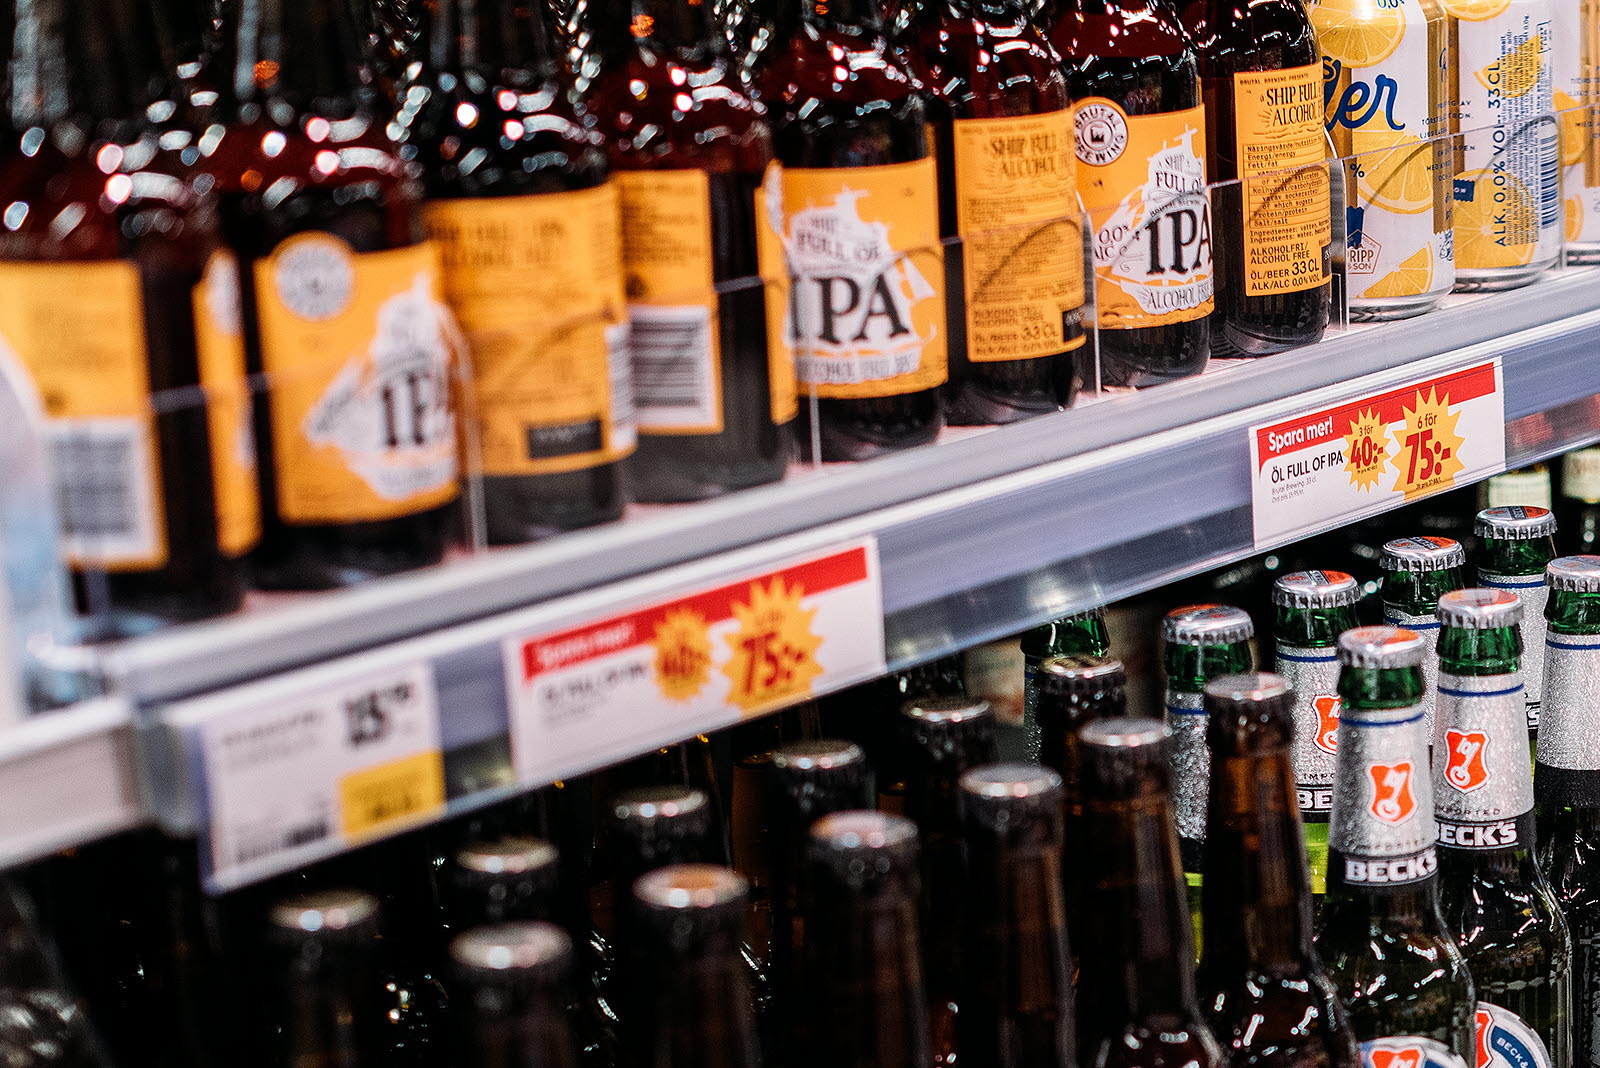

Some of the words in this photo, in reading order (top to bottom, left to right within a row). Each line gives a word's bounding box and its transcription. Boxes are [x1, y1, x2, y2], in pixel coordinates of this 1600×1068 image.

[1487, 57, 1501, 85] CL.
[1266, 86, 1296, 107] SHIP
[1299, 82, 1318, 102] FULL
[1487, 87, 1501, 109] 33
[1273, 102, 1318, 127] ALCOHOL
[1492, 160, 1507, 204] 0,0%
[1145, 203, 1214, 276] IPA
[1493, 208, 1507, 247] ALK.
[1250, 254, 1291, 266] ALCOHOL
[1292, 250, 1310, 261] FREE
[1350, 249, 1374, 263] RIPP
[1250, 268, 1290, 281] ÖL/BEER
[1291, 260, 1307, 276] 33
[1308, 258, 1320, 273] CL
[1251, 279, 1290, 291] ALK/ALC
[1359, 427, 1363, 437] 3
[1364, 424, 1373, 435] för
[1417, 416, 1423, 429] 6
[1425, 413, 1437, 427] för
[1269, 428, 1304, 453] Spara
[1306, 415, 1333, 441] mer!
[1351, 435, 1383, 470] 40:-
[1405, 428, 1451, 485] 75:-
[1271, 465, 1285, 484] ÖL
[1287, 460, 1310, 480] FULL
[1312, 454, 1326, 472] OF
[1328, 449, 1344, 468] IPA
[1435, 805, 1502, 817] MPORTED
[1344, 849, 1438, 883] BECK'S
